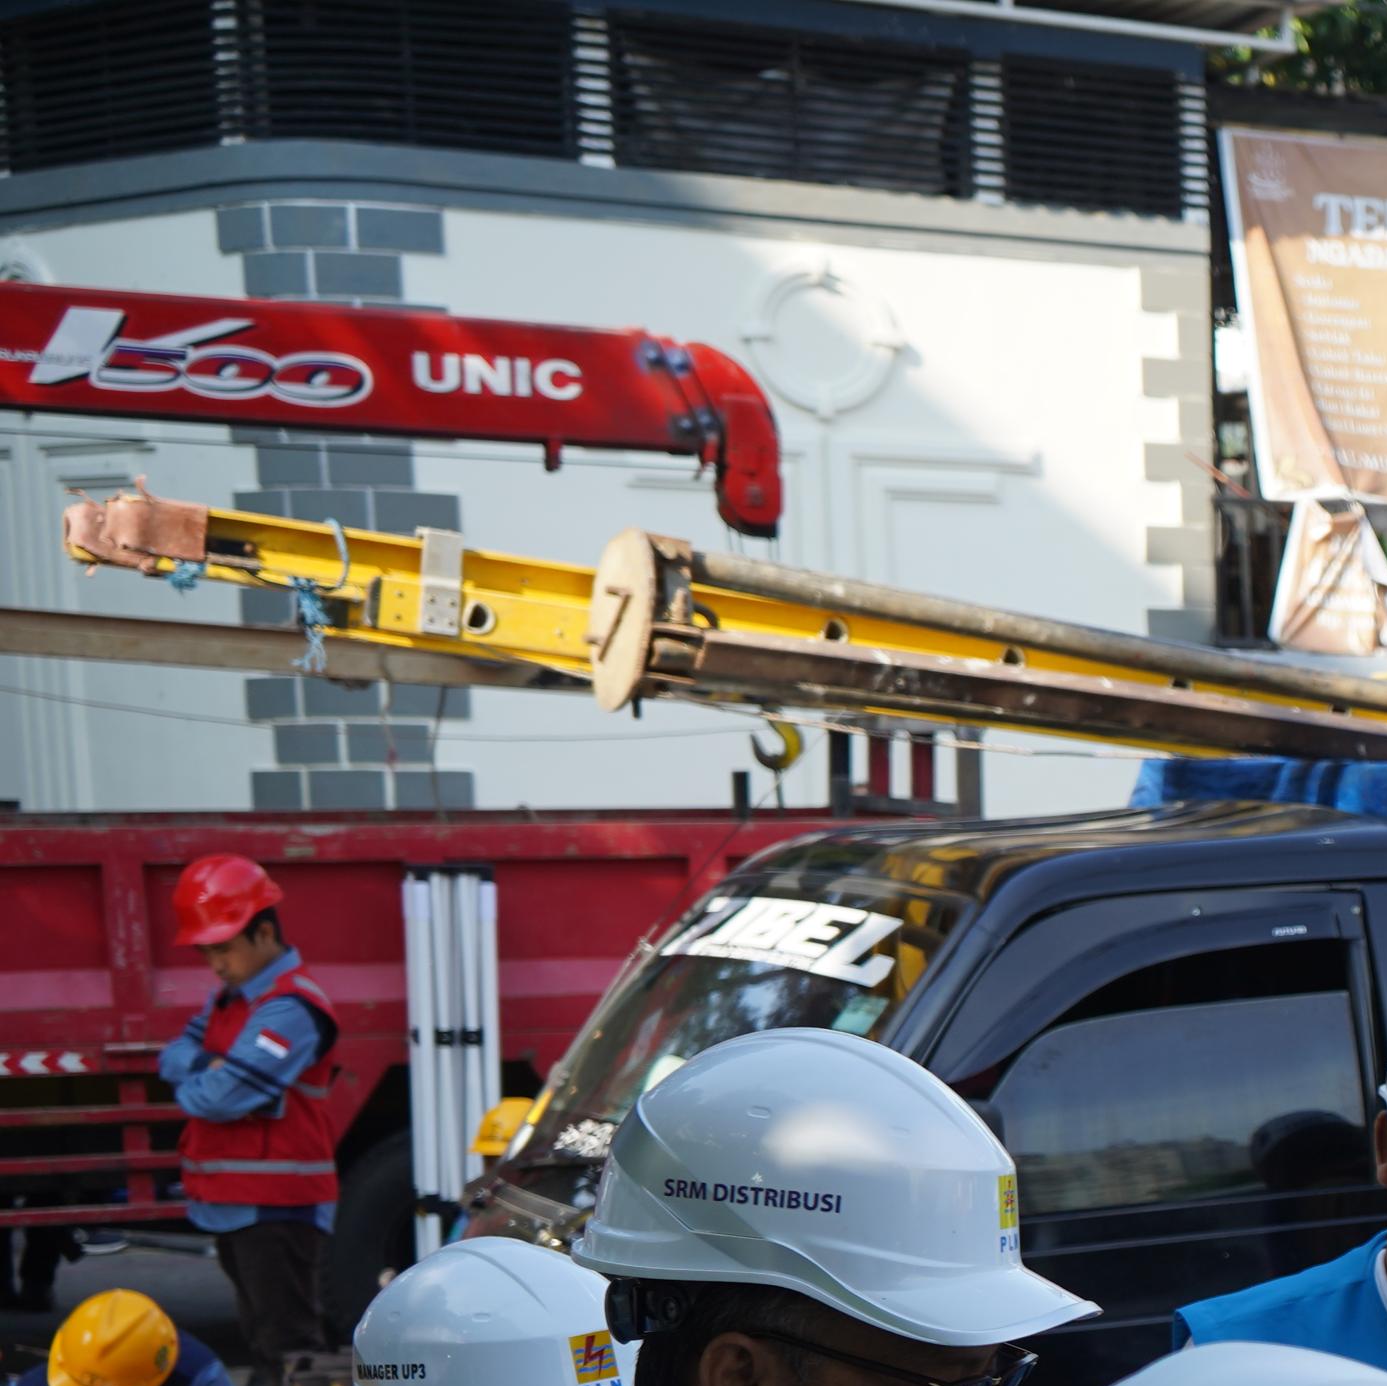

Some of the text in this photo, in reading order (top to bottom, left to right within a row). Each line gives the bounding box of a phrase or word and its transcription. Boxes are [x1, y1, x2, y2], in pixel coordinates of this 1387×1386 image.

[411, 350, 583, 400] UNIC
[664, 1178, 842, 1213] SRM DISTRIBUSI
[357, 1363, 426, 1380] MANAGER UP3
